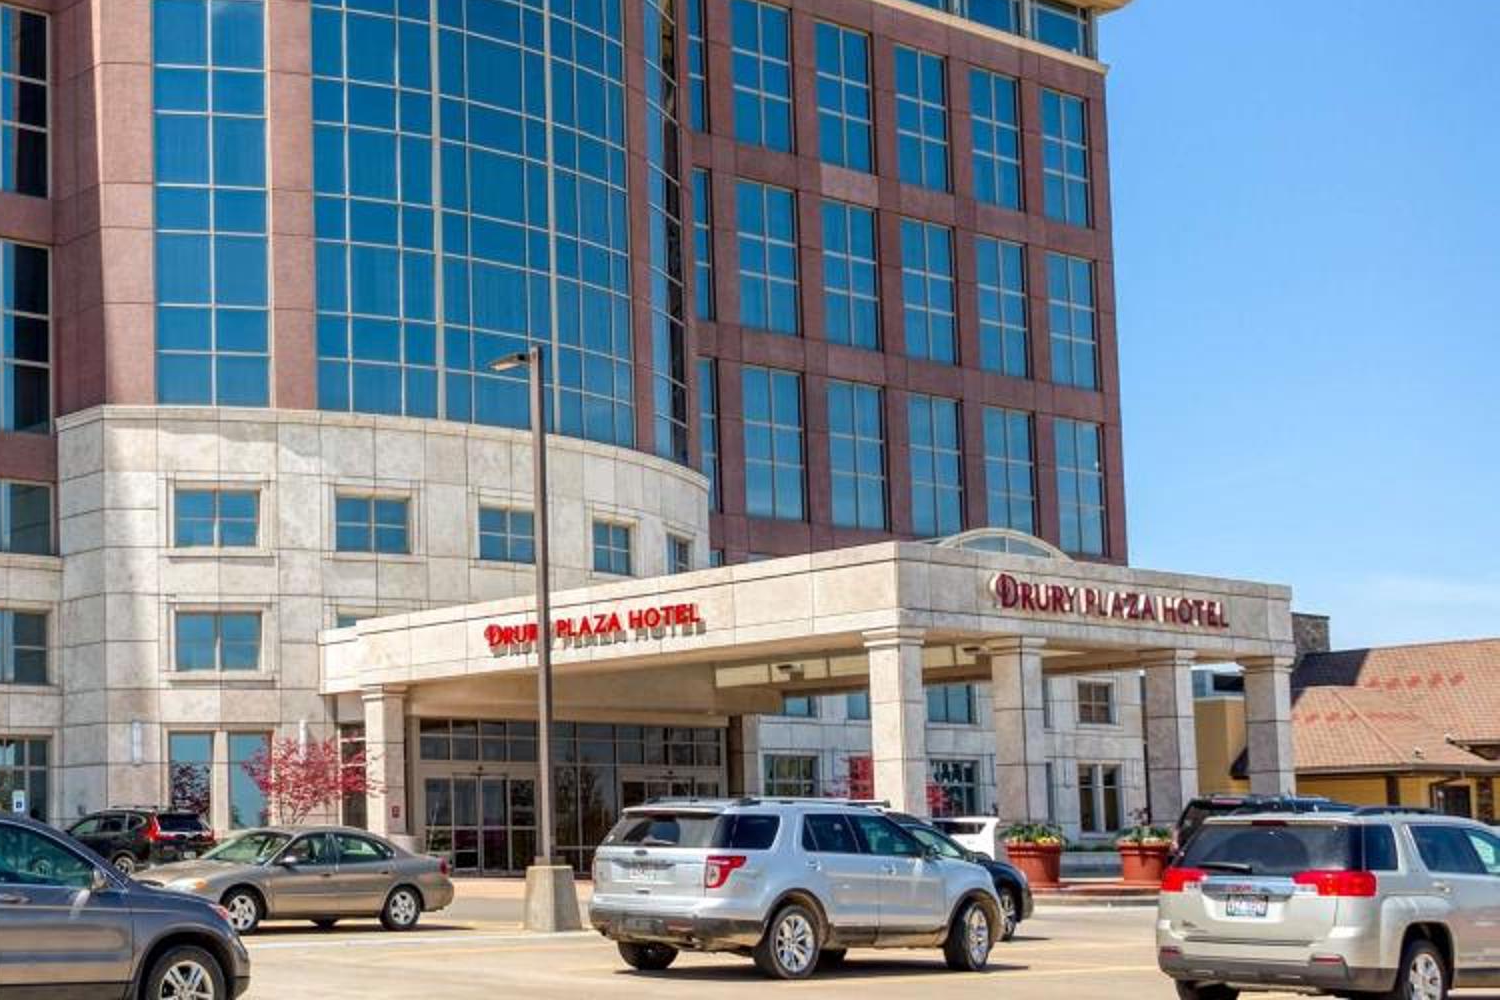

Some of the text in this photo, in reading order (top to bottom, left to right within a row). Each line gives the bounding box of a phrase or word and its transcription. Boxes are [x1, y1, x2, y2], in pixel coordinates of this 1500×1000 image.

[484, 603, 701, 647] DRUR PLAZA HOTEL
[995, 573, 1229, 628] DRURY PLAZA HOTEL
